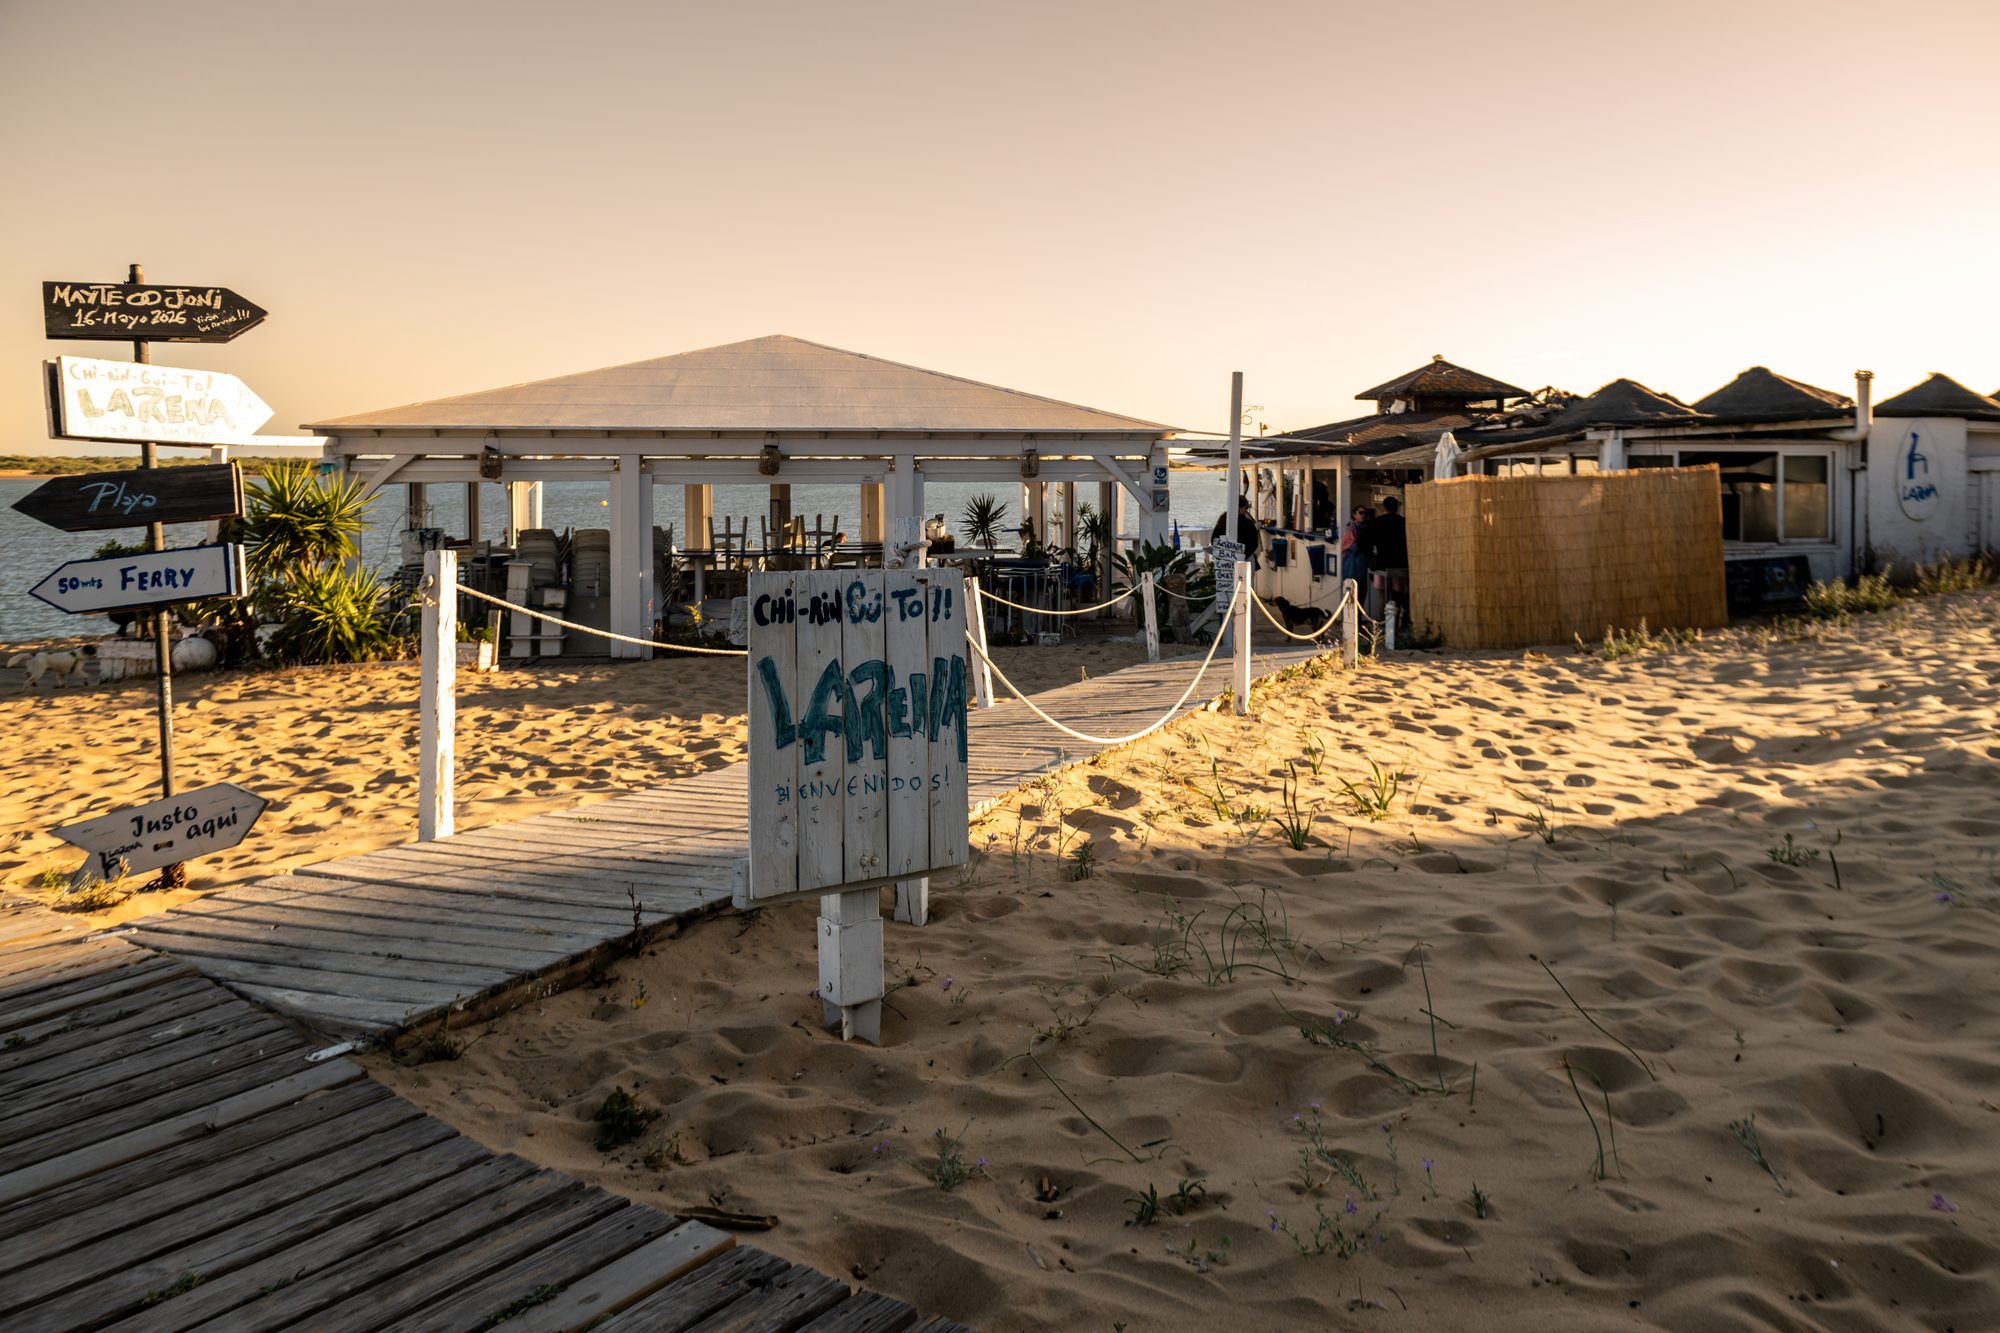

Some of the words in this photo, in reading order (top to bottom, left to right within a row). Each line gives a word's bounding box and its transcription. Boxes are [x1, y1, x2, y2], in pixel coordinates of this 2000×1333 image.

[52, 284, 125, 307] MAYTE
[149, 309, 188, 326] 2026
[79, 480, 157, 516] Playa
[1218, 549, 1237, 560] BAR
[119, 565, 196, 591] FERRY
[130, 805, 198, 838] Justo
